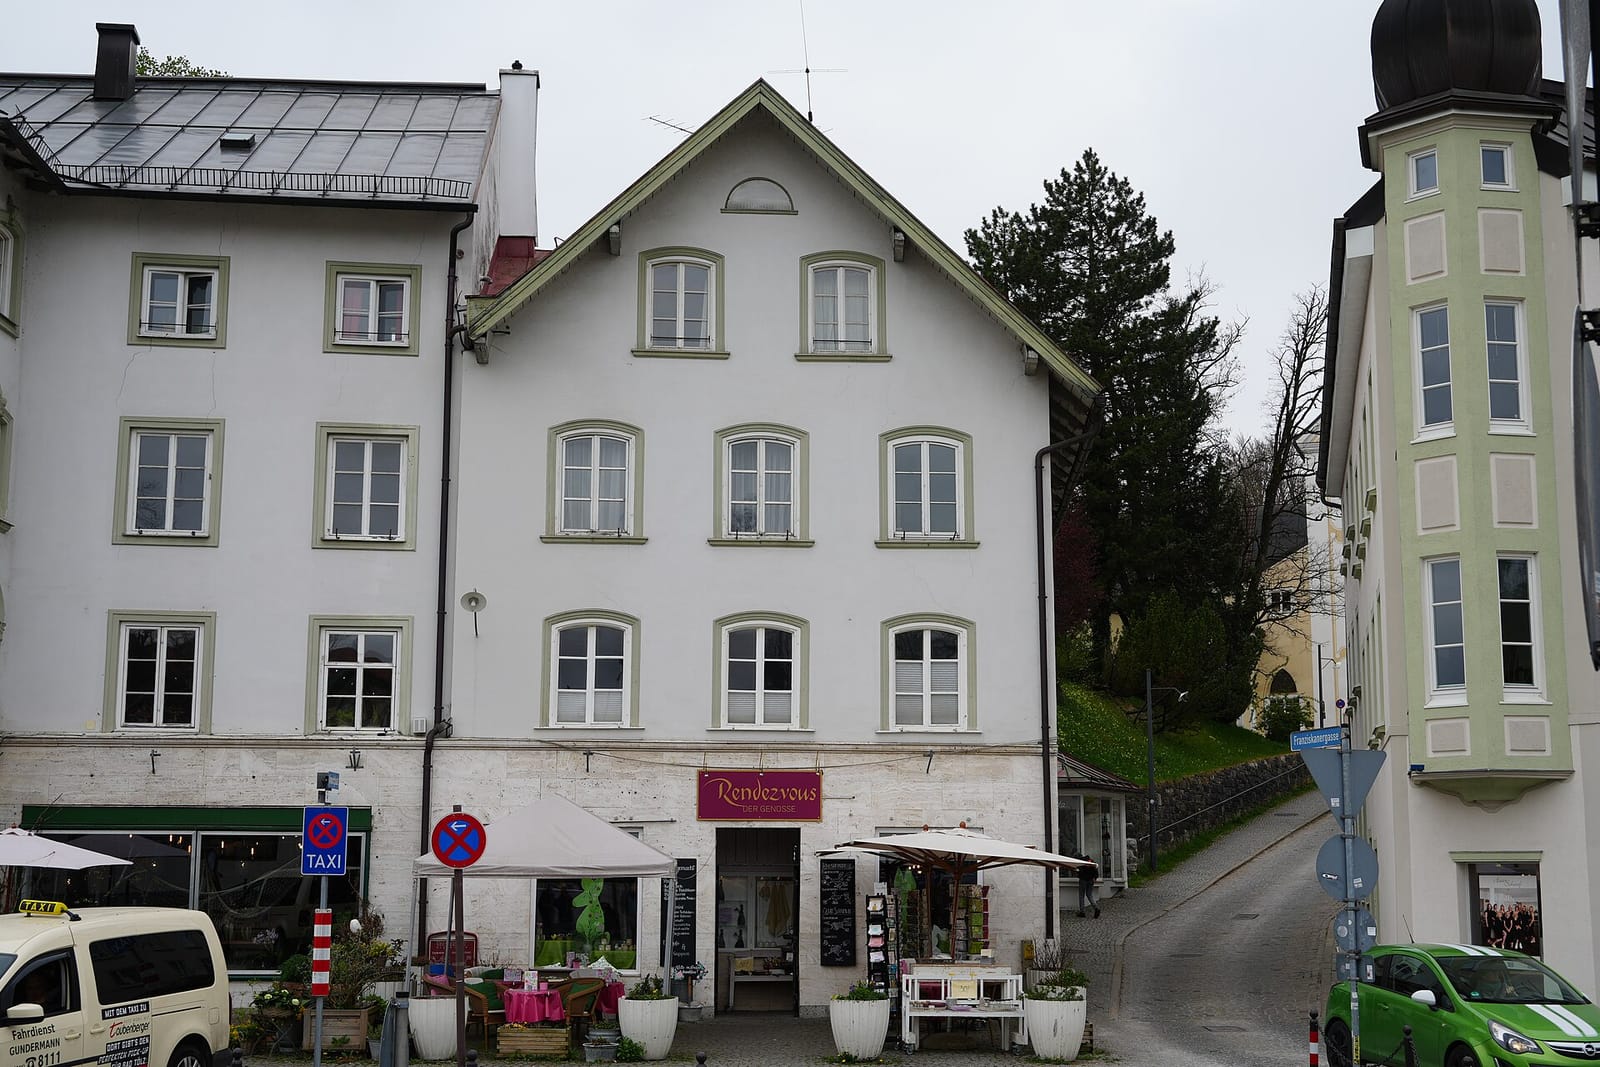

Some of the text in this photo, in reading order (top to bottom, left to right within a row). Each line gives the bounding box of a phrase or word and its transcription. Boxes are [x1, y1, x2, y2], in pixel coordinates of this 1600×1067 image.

[1293, 733, 1339, 745] Franziskanergasse
[703, 776, 817, 807] Rendezvous
[743, 804, 797, 813] DER GENOSSE
[306, 854, 341, 869] TAXI
[24, 902, 52, 912] TAXI
[104, 1003, 147, 1019] MIT DEM TAXI ZU
[12, 1023, 56, 1041] Fahrdienst
[9, 1038, 60, 1056] GUNDERMANN
[106, 1041, 121, 1053] DORT
[38, 1050, 60, 1067] 8111
